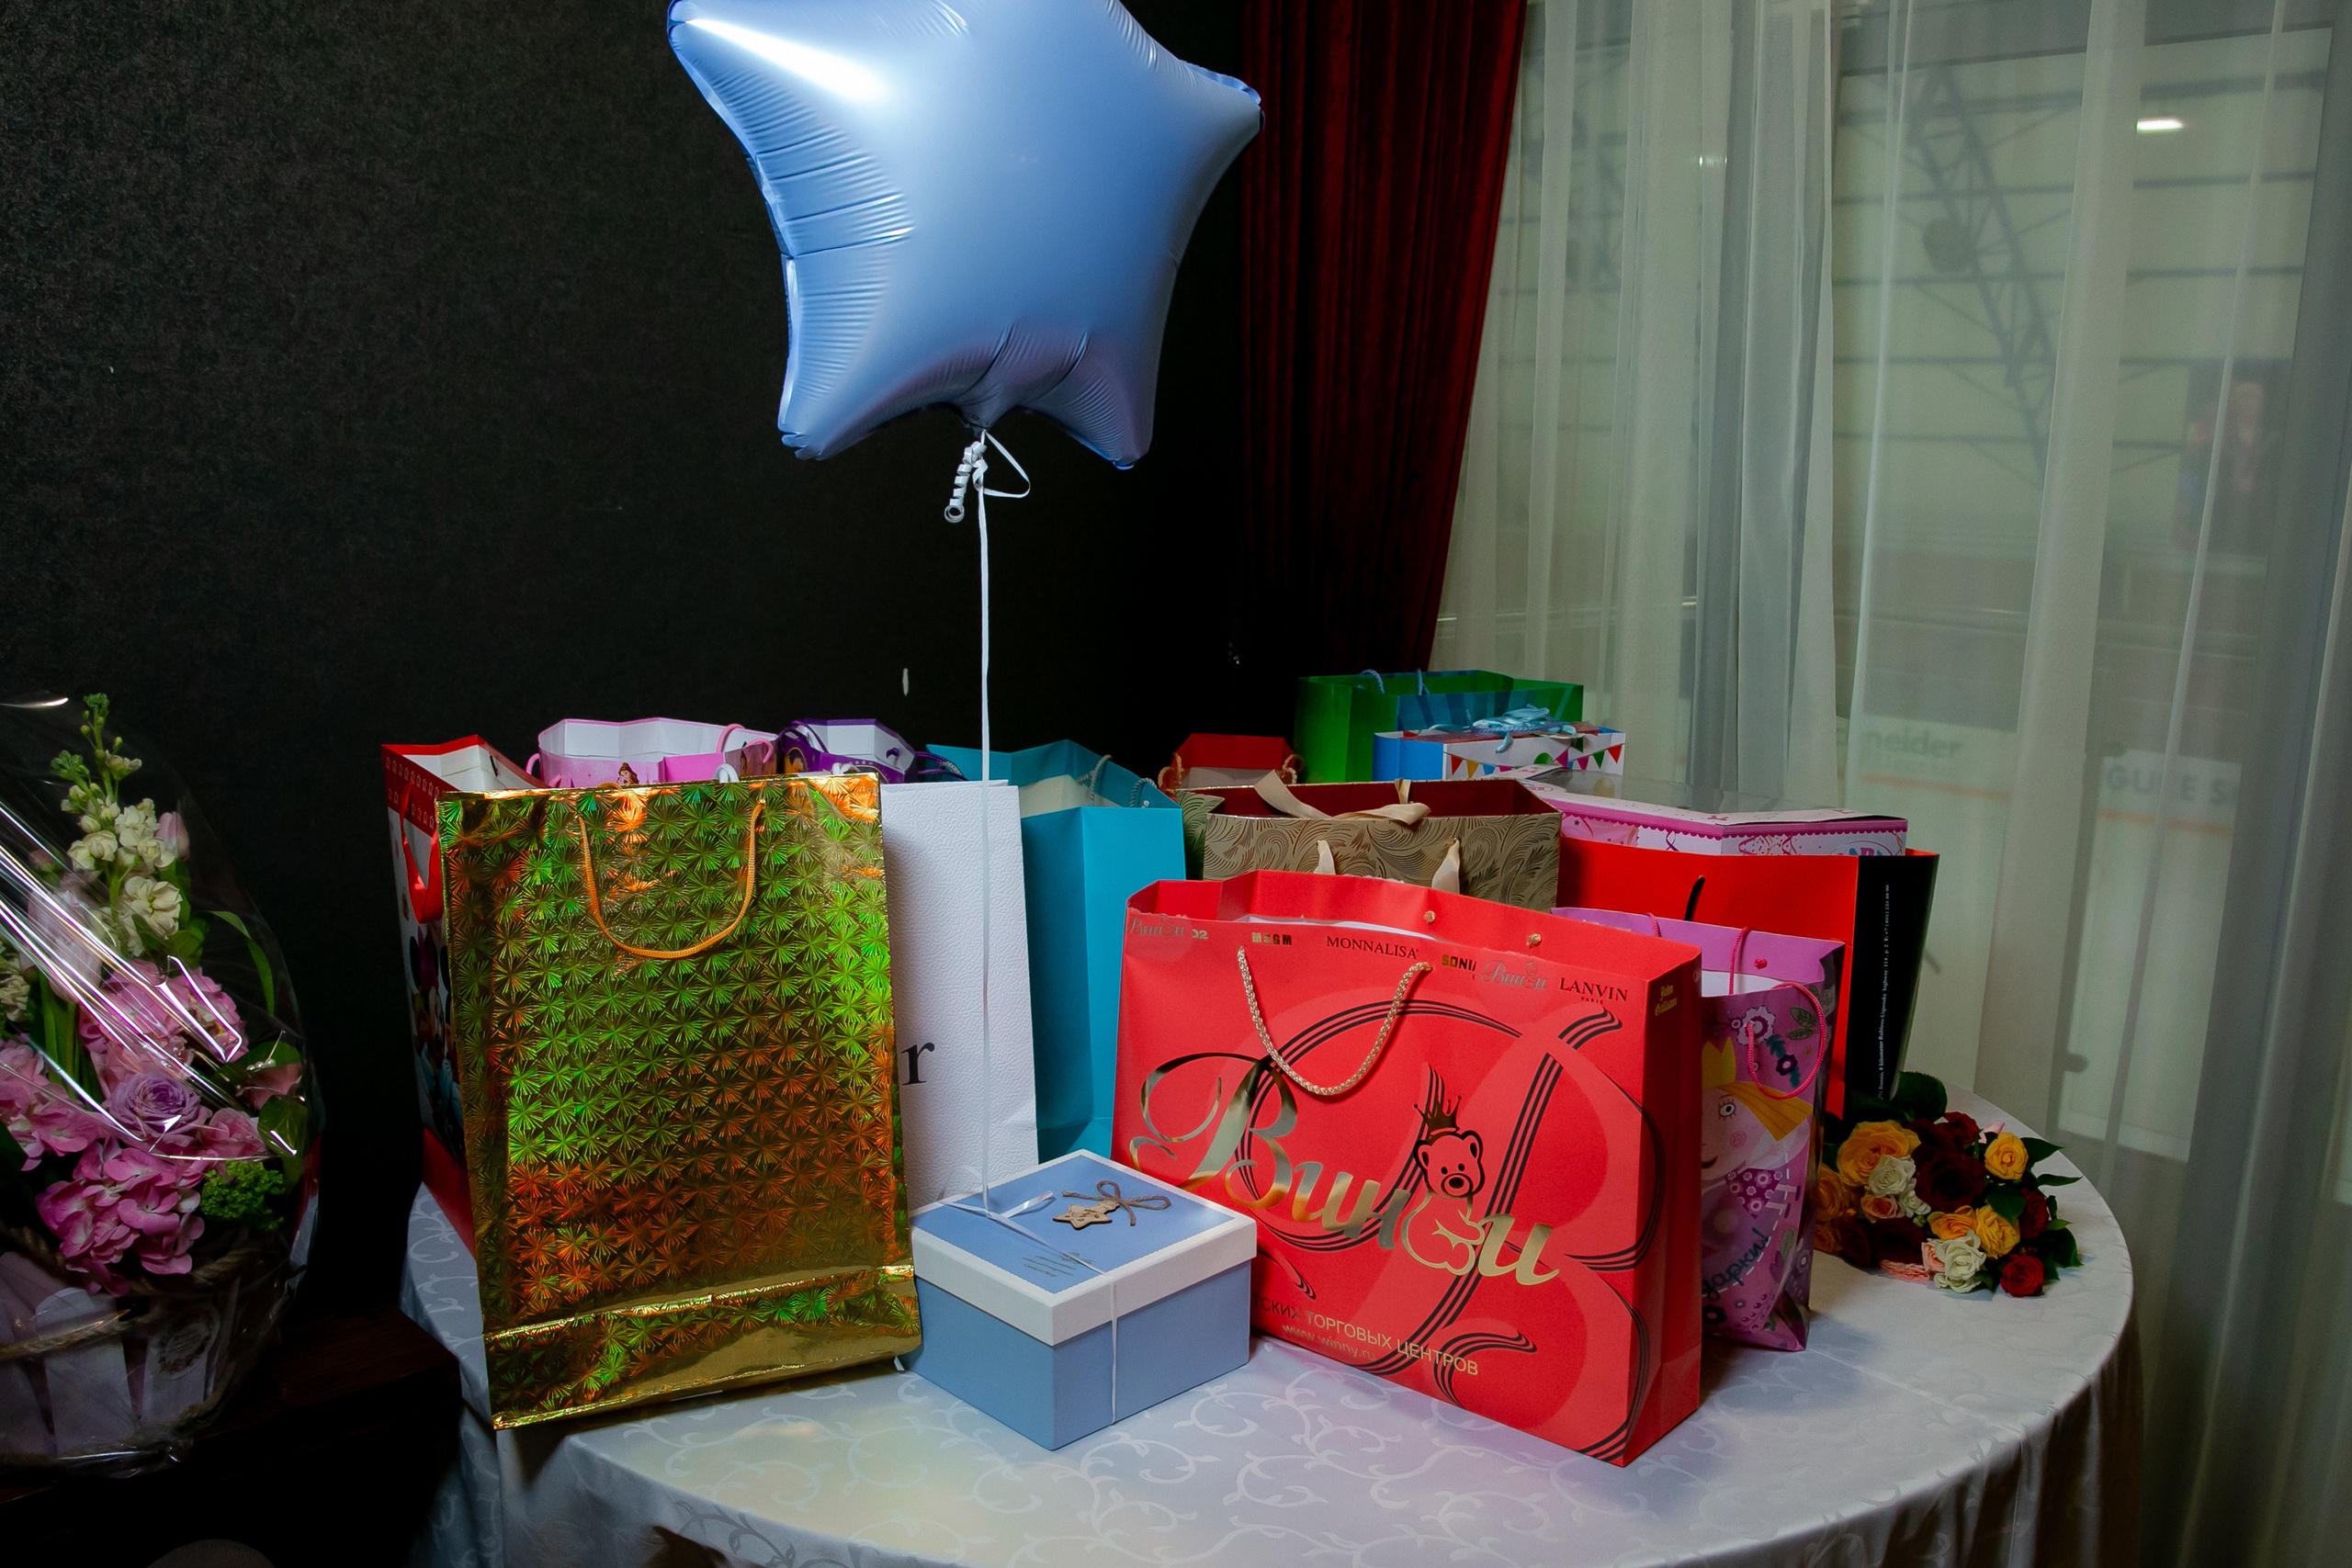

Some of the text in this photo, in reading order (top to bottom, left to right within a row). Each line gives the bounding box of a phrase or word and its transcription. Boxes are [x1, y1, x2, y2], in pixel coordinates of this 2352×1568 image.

[2106, 765, 2196, 801] GUE
[1251, 931, 1292, 945] MSGM
[1326, 935, 1418, 960] MONNALISA
[1560, 977, 1629, 1002] LANVIN
[1580, 996, 1604, 1005] PARIS
[1305, 1310, 1393, 1350] ТОРГОВЫХ
[1396, 1337, 1479, 1376] ЦЕНТРОВ
